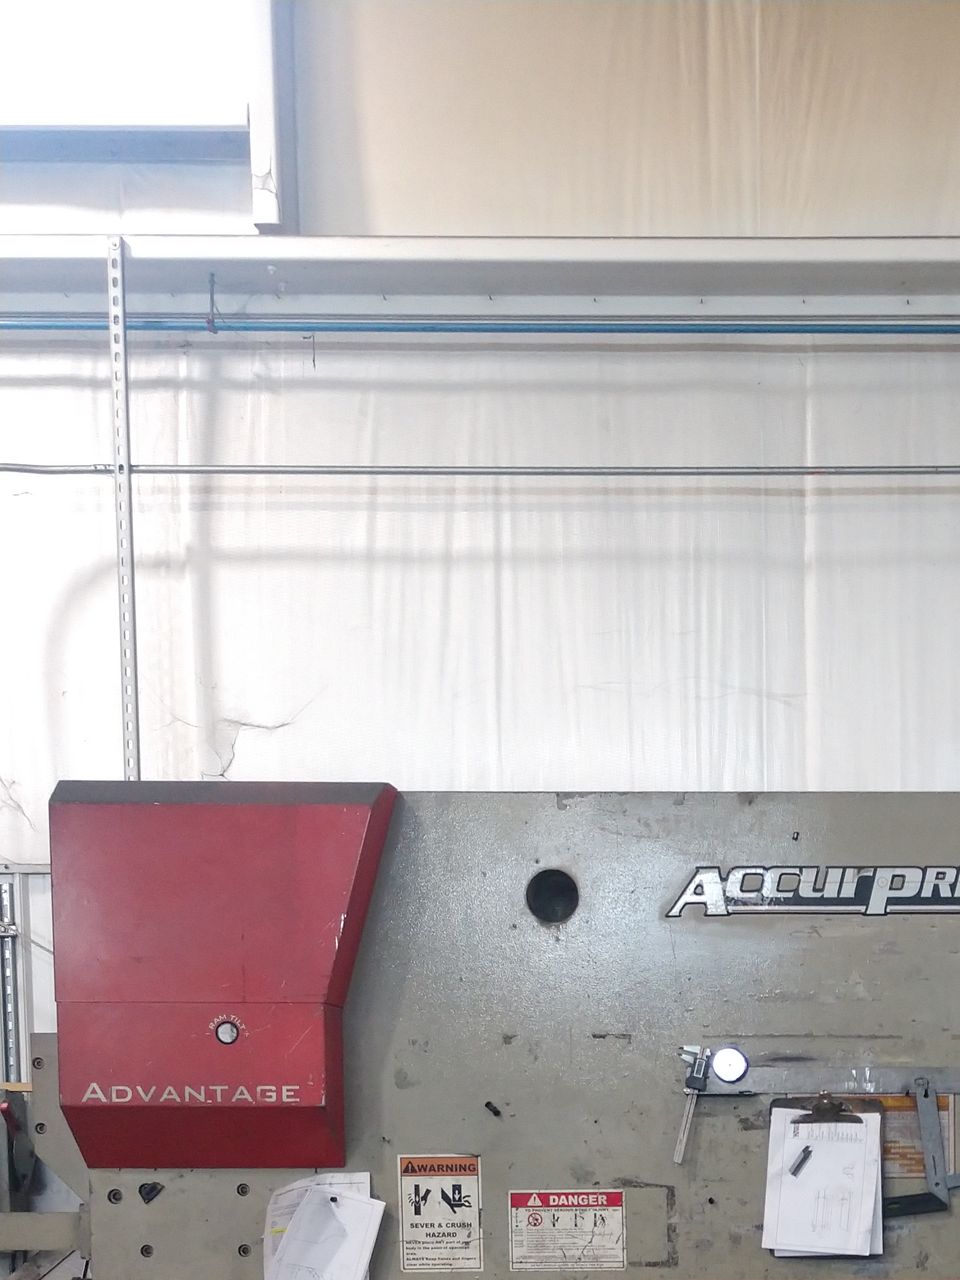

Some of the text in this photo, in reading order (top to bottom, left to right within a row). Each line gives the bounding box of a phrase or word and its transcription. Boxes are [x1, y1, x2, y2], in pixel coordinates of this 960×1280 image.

[208, 1014, 246, 1030] RAM TILT
[81, 1082, 300, 1103] ADVANTAGE
[417, 1163, 477, 1173] WARNING
[549, 1194, 608, 1206] DANGER
